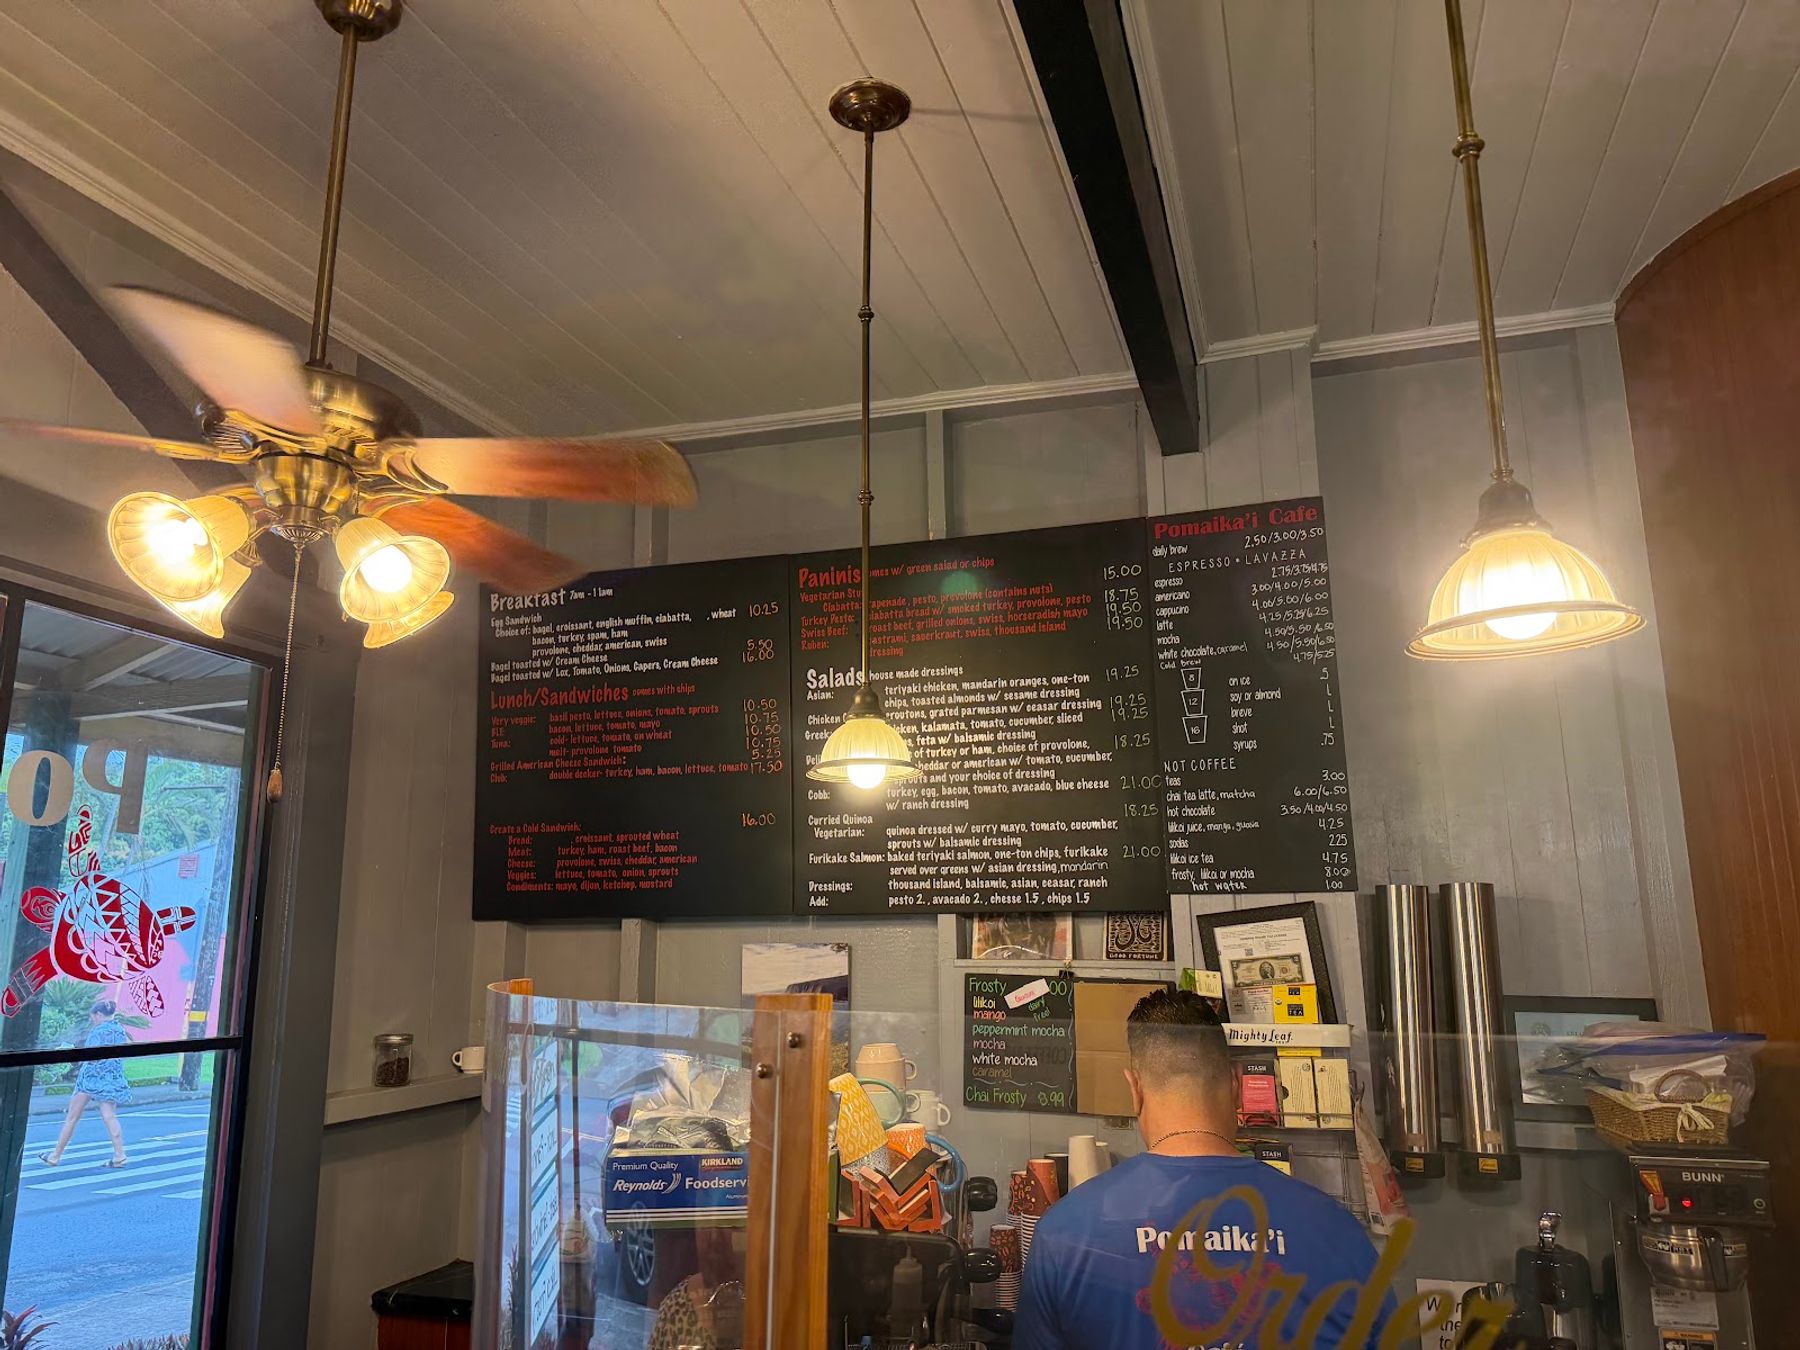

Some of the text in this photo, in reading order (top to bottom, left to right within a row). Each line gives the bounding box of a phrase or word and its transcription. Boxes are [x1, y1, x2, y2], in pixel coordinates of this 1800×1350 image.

[1154, 505, 1317, 539] Pomaika'i Cafe
[1169, 549, 1306, 572] ESPRESSO LAVAZZA
[799, 565, 861, 589] Paninis
[907, 565, 931, 575] green
[934, 560, 957, 571] salad
[960, 560, 969, 568] or
[972, 557, 995, 567] chips
[1104, 565, 1141, 580] 15.00
[1154, 578, 1183, 590] espresso
[1105, 588, 1138, 602] 18.75
[1155, 591, 1190, 602] americano
[1106, 602, 1141, 617] 19.50
[491, 614, 542, 628] Egg Sandwich
[1107, 617, 1143, 630] 19.50
[1156, 620, 1173, 631] latte
[1157, 635, 1180, 645] mocha
[807, 666, 963, 689] Salads house made dressings
[807, 665, 1139, 700] Asian: teriyaki chicken, mandarin oranges, one-ton 19.25
[491, 683, 628, 709] Lunch/Sandwiches
[657, 685, 675, 694] with
[677, 683, 695, 695] chips
[1230, 688, 1281, 703] soy or almond
[744, 699, 776, 711] 10.50
[808, 713, 840, 725] Chicken
[930, 707, 958, 717] grated
[961, 705, 1008, 717] parmesan
[1027, 701, 1058, 712] ceasar
[1061, 699, 1102, 710] dressing
[1110, 693, 1146, 708] 19.25
[1231, 707, 1252, 717] breve
[745, 712, 779, 724] 10.75
[921, 707, 1148, 733] kalamata, tomato, cucumber, sliced 19.25
[746, 724, 781, 736] 10.50
[1191, 726, 1200, 734] 16
[1232, 722, 1248, 733] shot
[746, 737, 781, 750] 10.75
[926, 733, 1150, 757] turkey ham, choice of provolone, 18.25
[1233, 740, 1257, 752] syrups
[752, 749, 781, 759] 5.25
[751, 760, 783, 774] 17.50
[1164, 758, 1237, 772] NOT COFFEE
[930, 768, 1056, 783] and your choice of dressing
[1166, 769, 1346, 786] teas 3.00
[1166, 789, 1256, 801] chai tea latte, matcha
[902, 800, 929, 810] ranch
[931, 798, 969, 809] dressing
[808, 804, 1158, 825] Curried Quinoa 18.25
[1167, 806, 1216, 817] hot chocolate
[742, 813, 776, 827] 16.00
[814, 828, 864, 840] Vegetarian:
[886, 827, 915, 837] quinoa
[918, 824, 952, 835] dressed
[971, 824, 997, 834] curry
[1000, 823, 1028, 832] mayo,
[1031, 821, 1068, 831] tomato,
[1071, 819, 1118, 830] cucumber,
[809, 846, 1161, 864] Furikake Salmon: baked teriyaki salmon, one-ton chips, furikake 21.00
[890, 866, 917, 875] served
[919, 866, 937, 874] over
[940, 865, 969, 875] greens
[988, 861, 1014, 872] asian
[1060, 860, 1109, 873] mandarin
[809, 876, 1108, 892] Dressings: thousand island, balsamic, asian, ceasar, ranch
[969, 977, 1006, 996] Frosty
[974, 1010, 1006, 1022] mango
[972, 1024, 1065, 1036] peppermint mocha
[1229, 1029, 1267, 1042] Mighty
[974, 1038, 1006, 1049] mocha
[972, 1052, 1000, 1064] white
[1005, 1053, 1038, 1066] mocha
[972, 1067, 1012, 1079] caramel
[966, 1086, 988, 1101] Chai
[994, 1088, 1027, 1107] Frosty
[613, 1158, 743, 1171] Premium Quality KIRKLAND
[1682, 1172, 1721, 1182] BUNN
[612, 1180, 668, 1194] Reynolds
[1136, 1226, 1286, 1255] Pomaika'i
